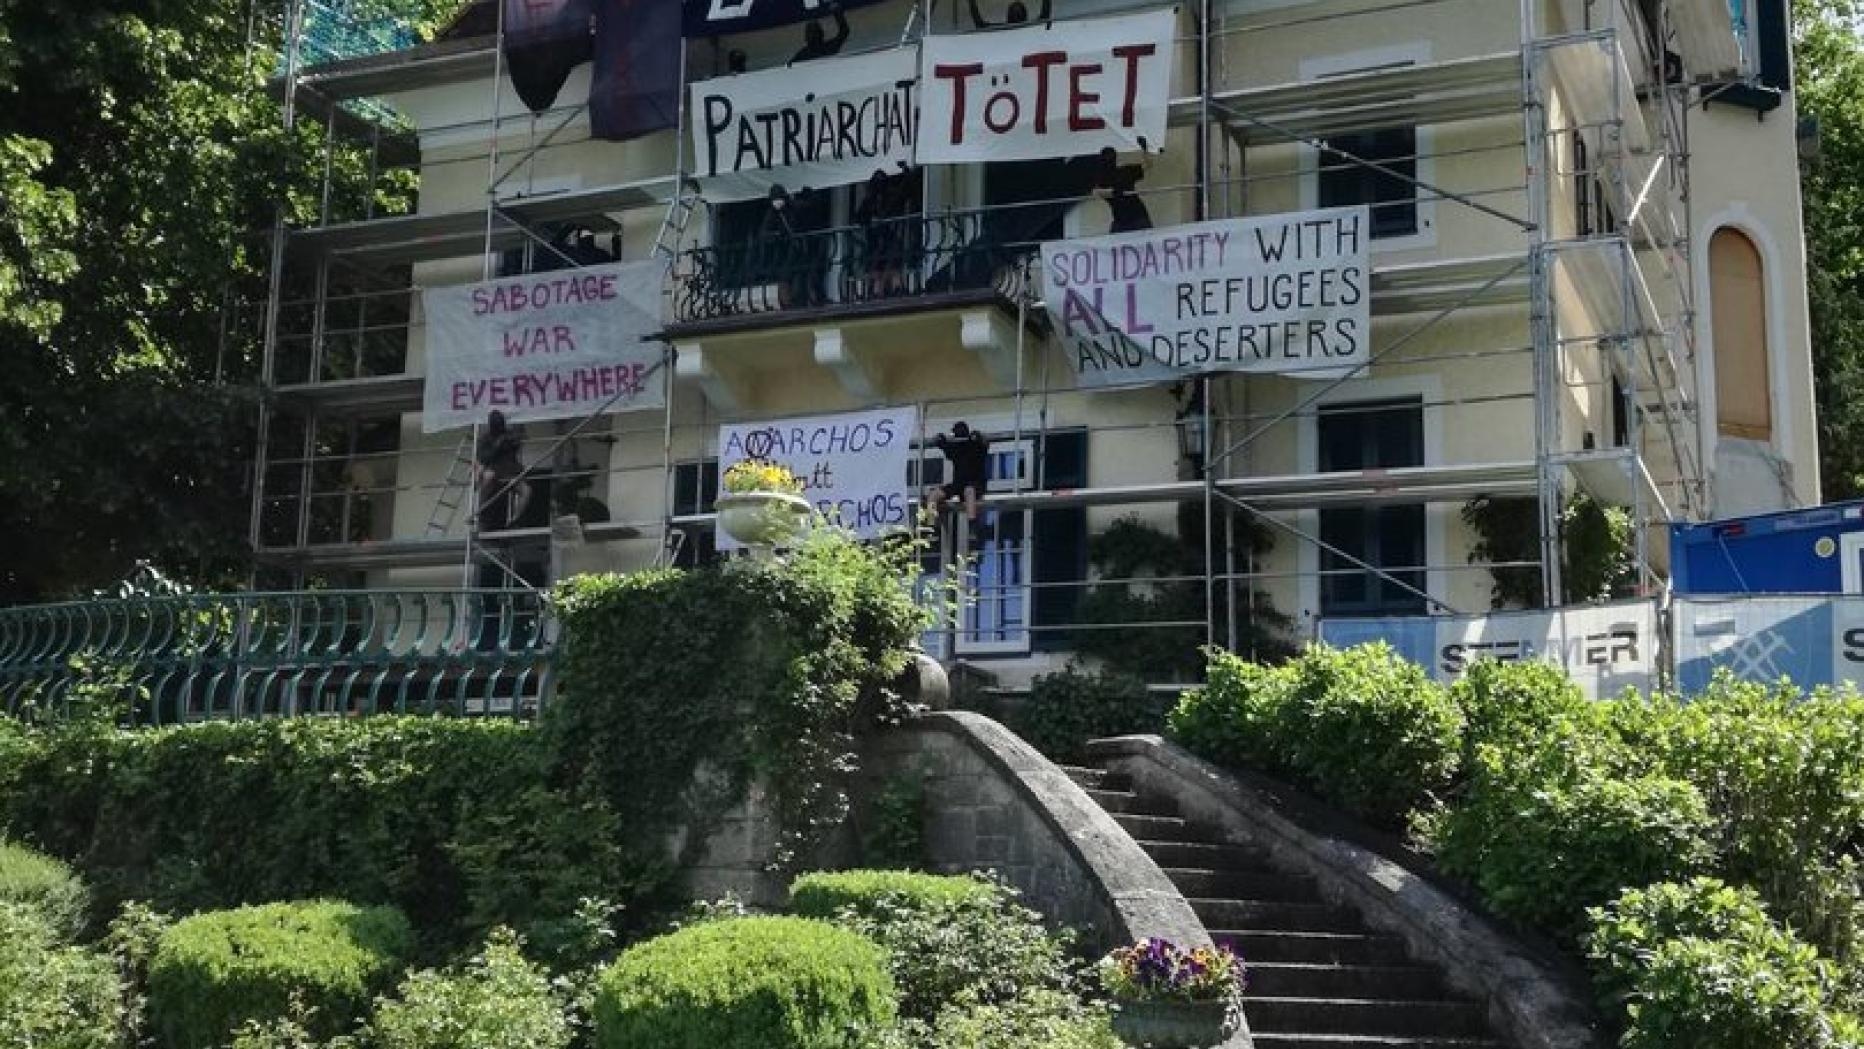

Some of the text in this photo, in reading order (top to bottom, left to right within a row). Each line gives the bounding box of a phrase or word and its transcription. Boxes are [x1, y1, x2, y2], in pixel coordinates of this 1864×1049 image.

[1051, 216, 1360, 287] SOLIDARITY WITH
[472, 274, 618, 316] SABOTAGE
[1062, 267, 1361, 337] ALL REFUGEES
[503, 325, 576, 358] WAR
[1077, 318, 1358, 373] AND DESERTERS
[451, 363, 646, 411] EVERYWHERE
